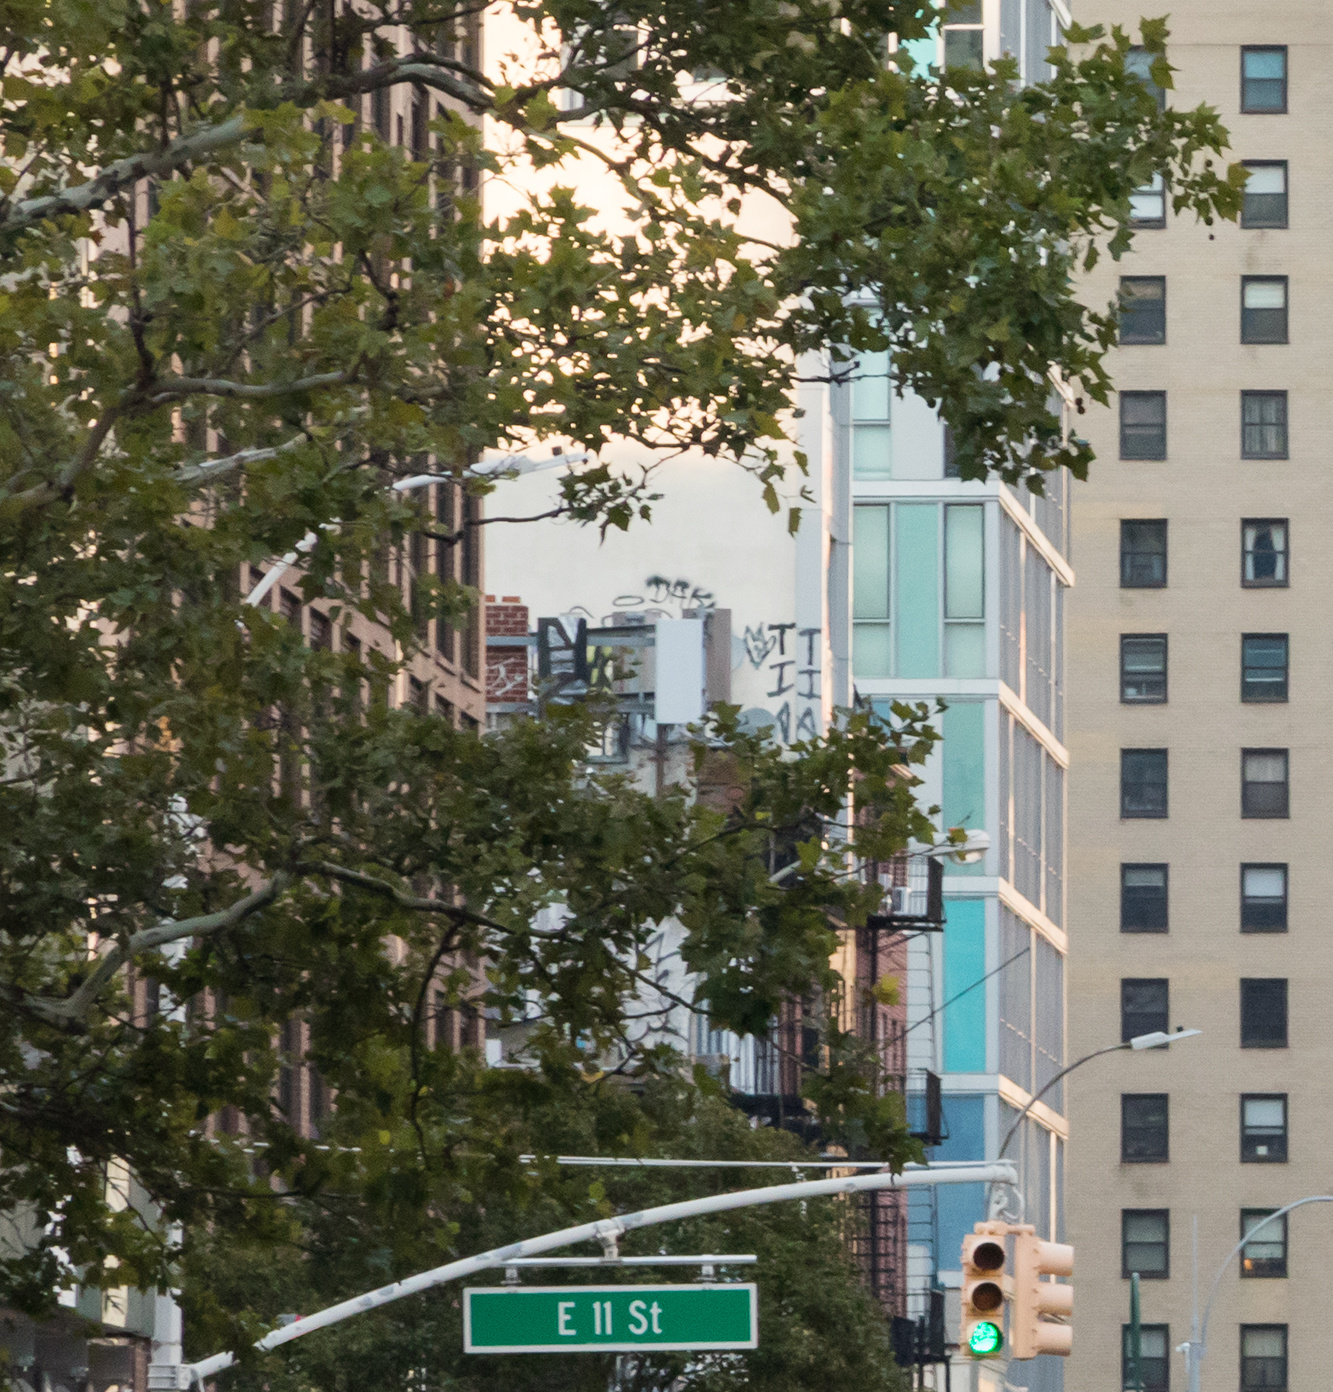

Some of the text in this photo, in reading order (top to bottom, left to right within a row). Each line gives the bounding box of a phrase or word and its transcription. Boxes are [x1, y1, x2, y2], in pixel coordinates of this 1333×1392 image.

[558, 1300, 663, 1336] E 11 St
